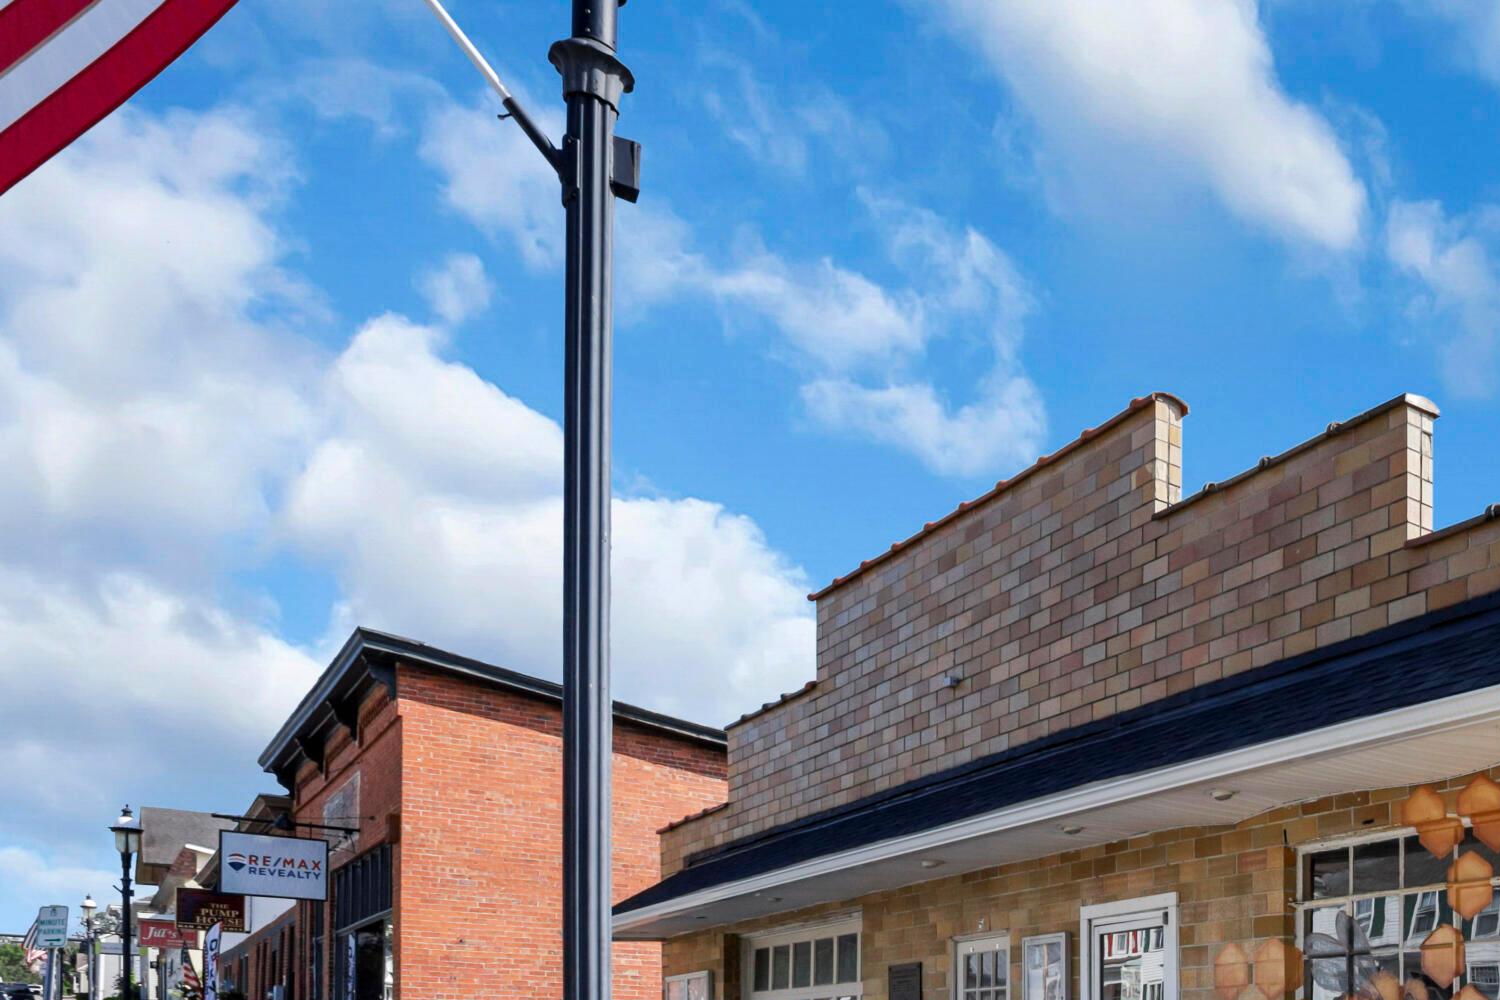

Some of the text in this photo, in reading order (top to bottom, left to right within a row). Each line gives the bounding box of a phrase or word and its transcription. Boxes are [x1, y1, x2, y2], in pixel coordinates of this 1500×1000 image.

[248, 854, 321, 871] RE/MAX
[248, 866, 321, 880] REVEALTY
[200, 908, 239, 918] PUMP
[143, 927, 176, 940] Jill's
